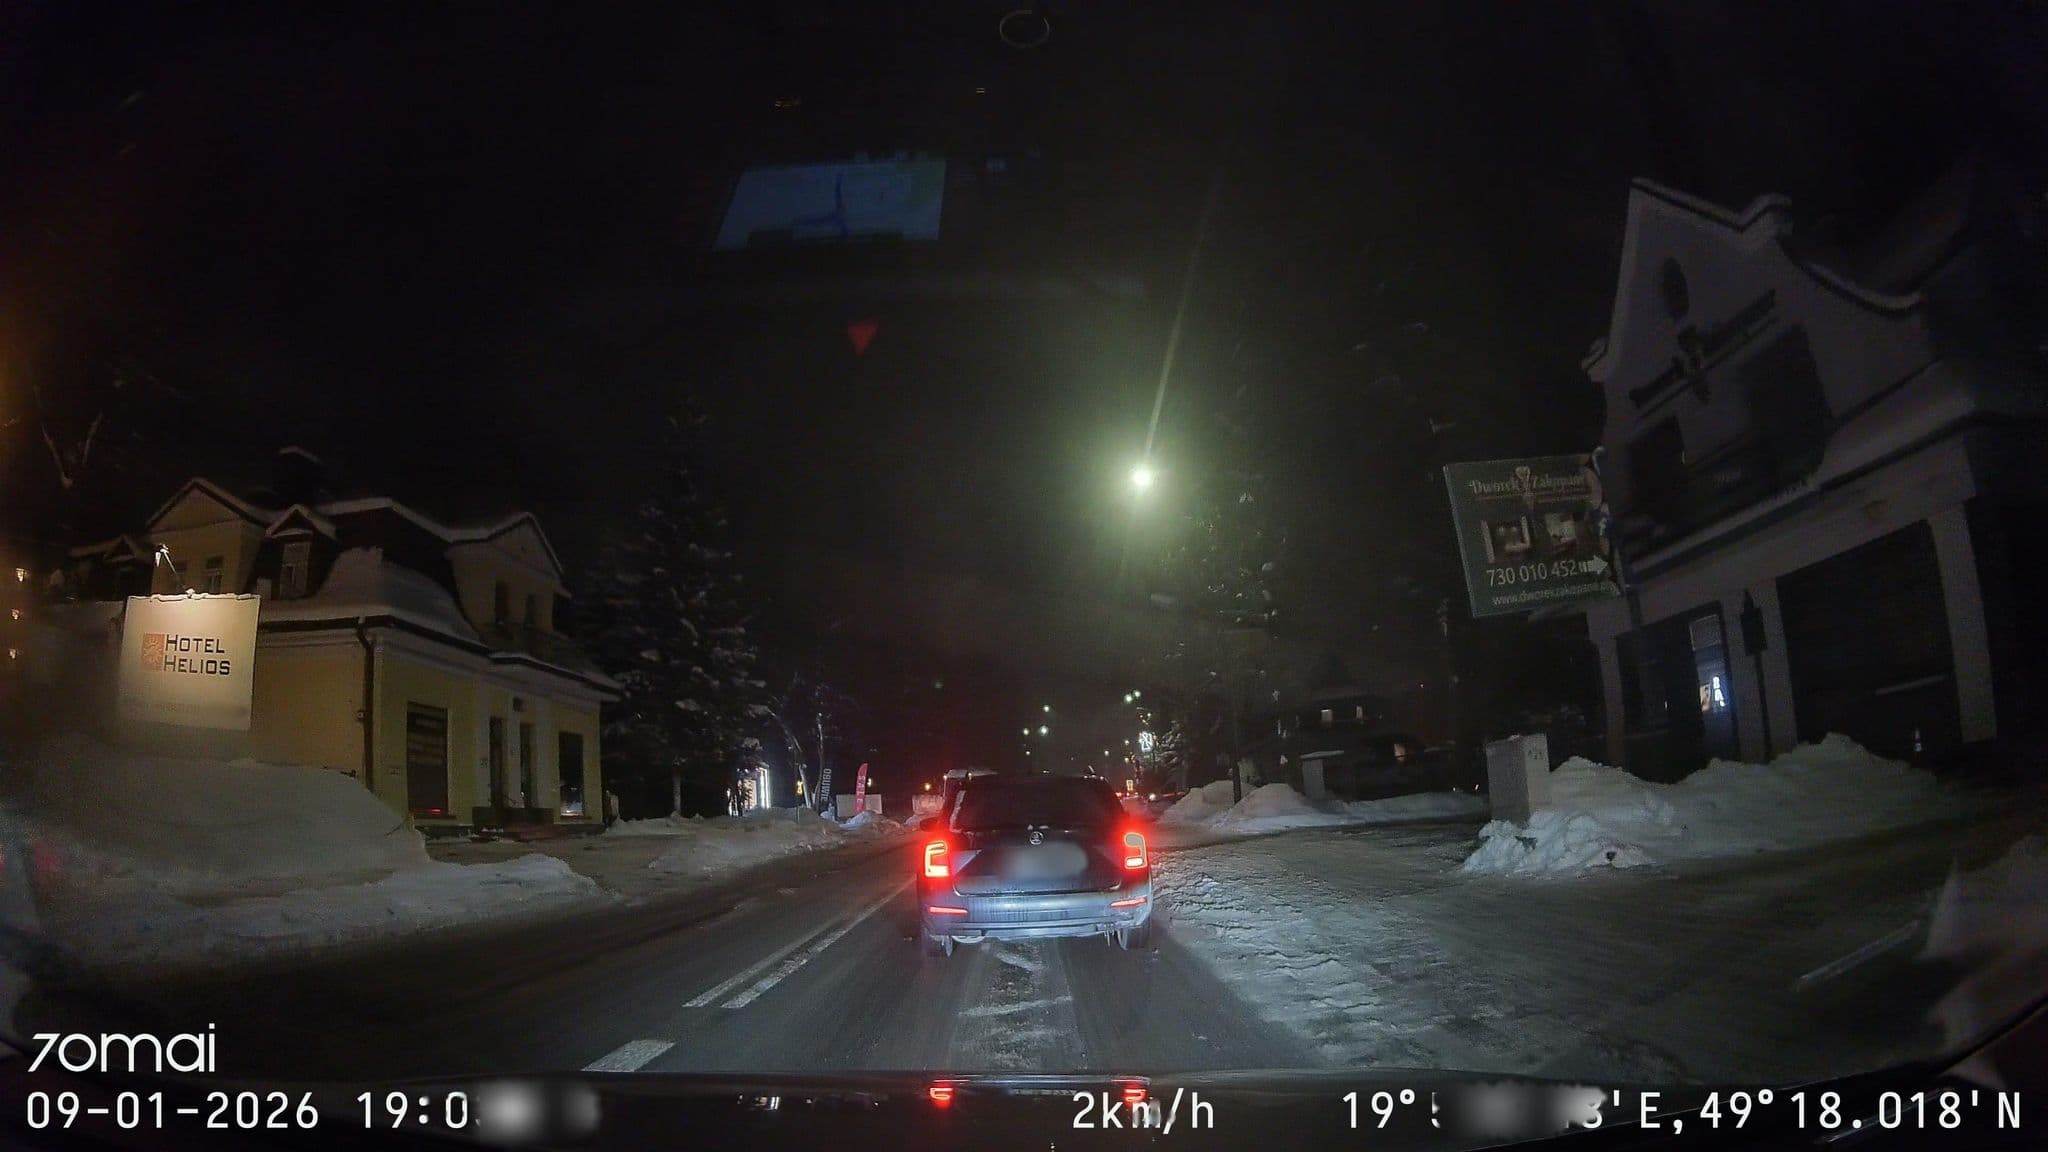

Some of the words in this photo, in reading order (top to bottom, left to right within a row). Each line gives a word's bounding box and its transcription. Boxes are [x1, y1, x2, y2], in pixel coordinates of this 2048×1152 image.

[1486, 567, 1516, 587] 730
[1519, 562, 1547, 583] 010
[1551, 558, 1577, 577] 452
[165, 634, 225, 653] HOTEL
[164, 655, 230, 675] HELIOS
